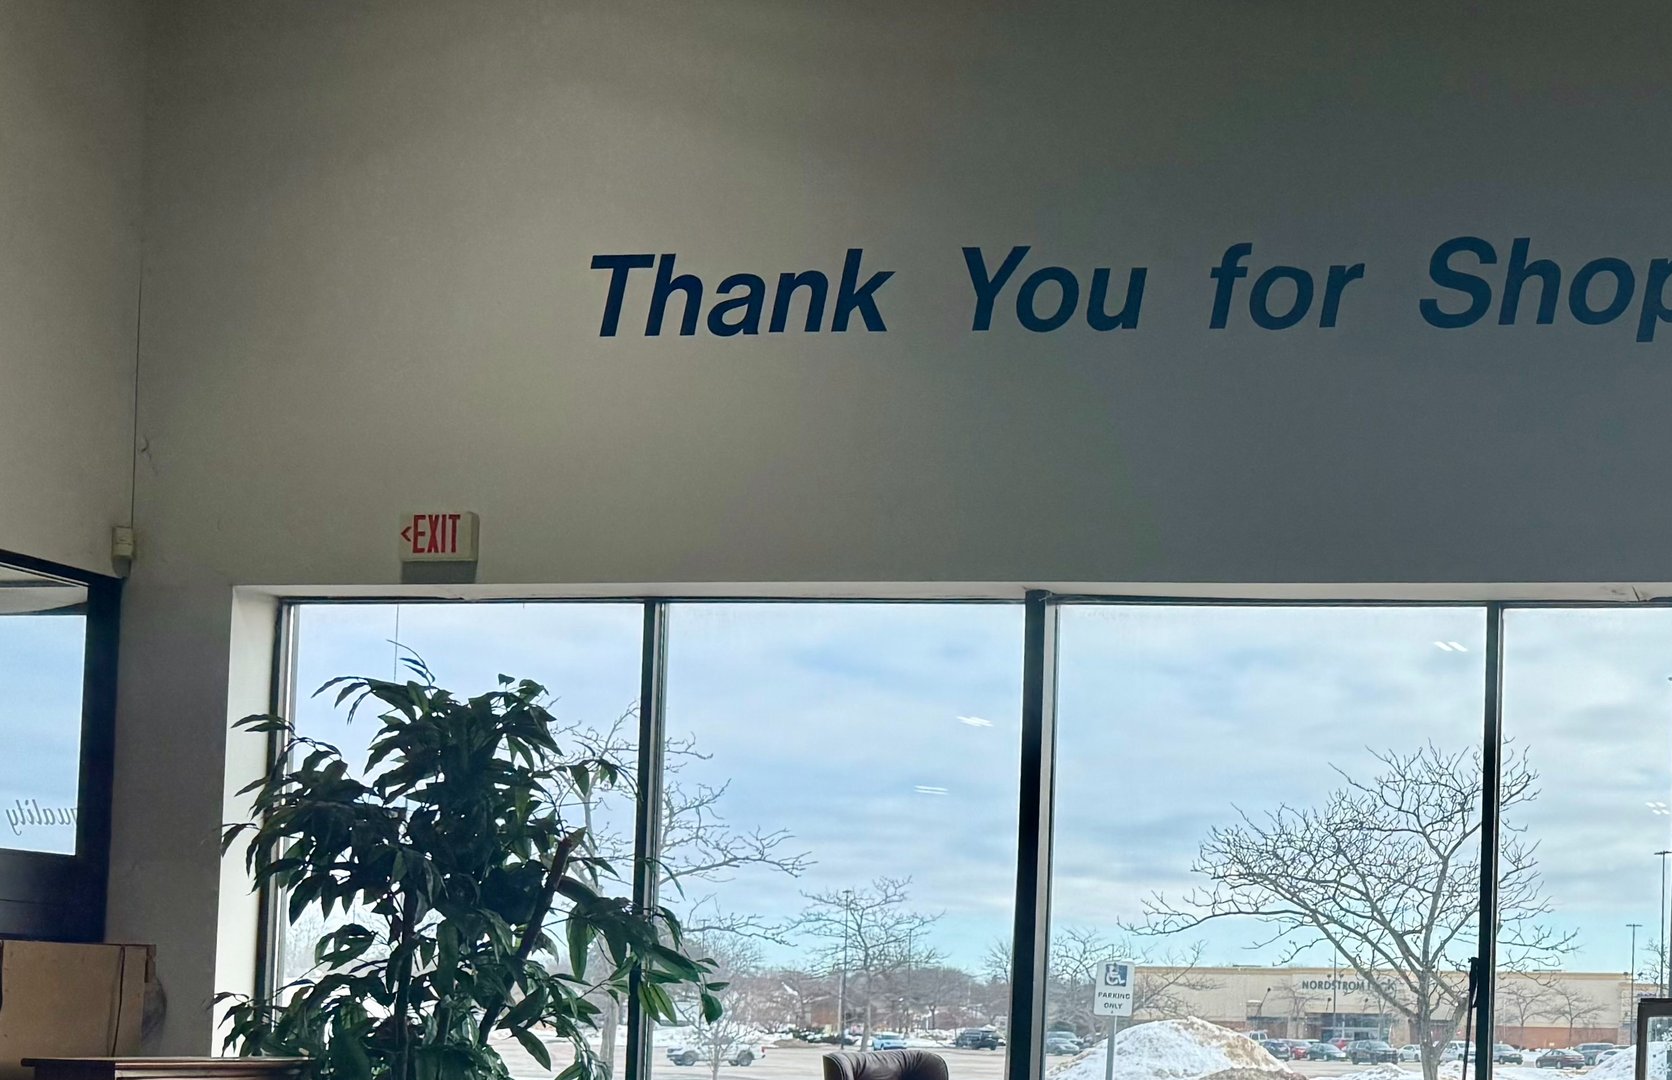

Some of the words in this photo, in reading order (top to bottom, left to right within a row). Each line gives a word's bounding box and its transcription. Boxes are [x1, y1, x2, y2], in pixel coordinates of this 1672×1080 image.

[590, 248, 896, 338] Thank
[961, 245, 1148, 333] You
[1208, 243, 1365, 330] for
[412, 514, 461, 553] EXIT
[1302, 980, 1364, 991] NORDSTROM
[1097, 991, 1131, 1000] PARKING
[1103, 1002, 1123, 1010] ONLY
